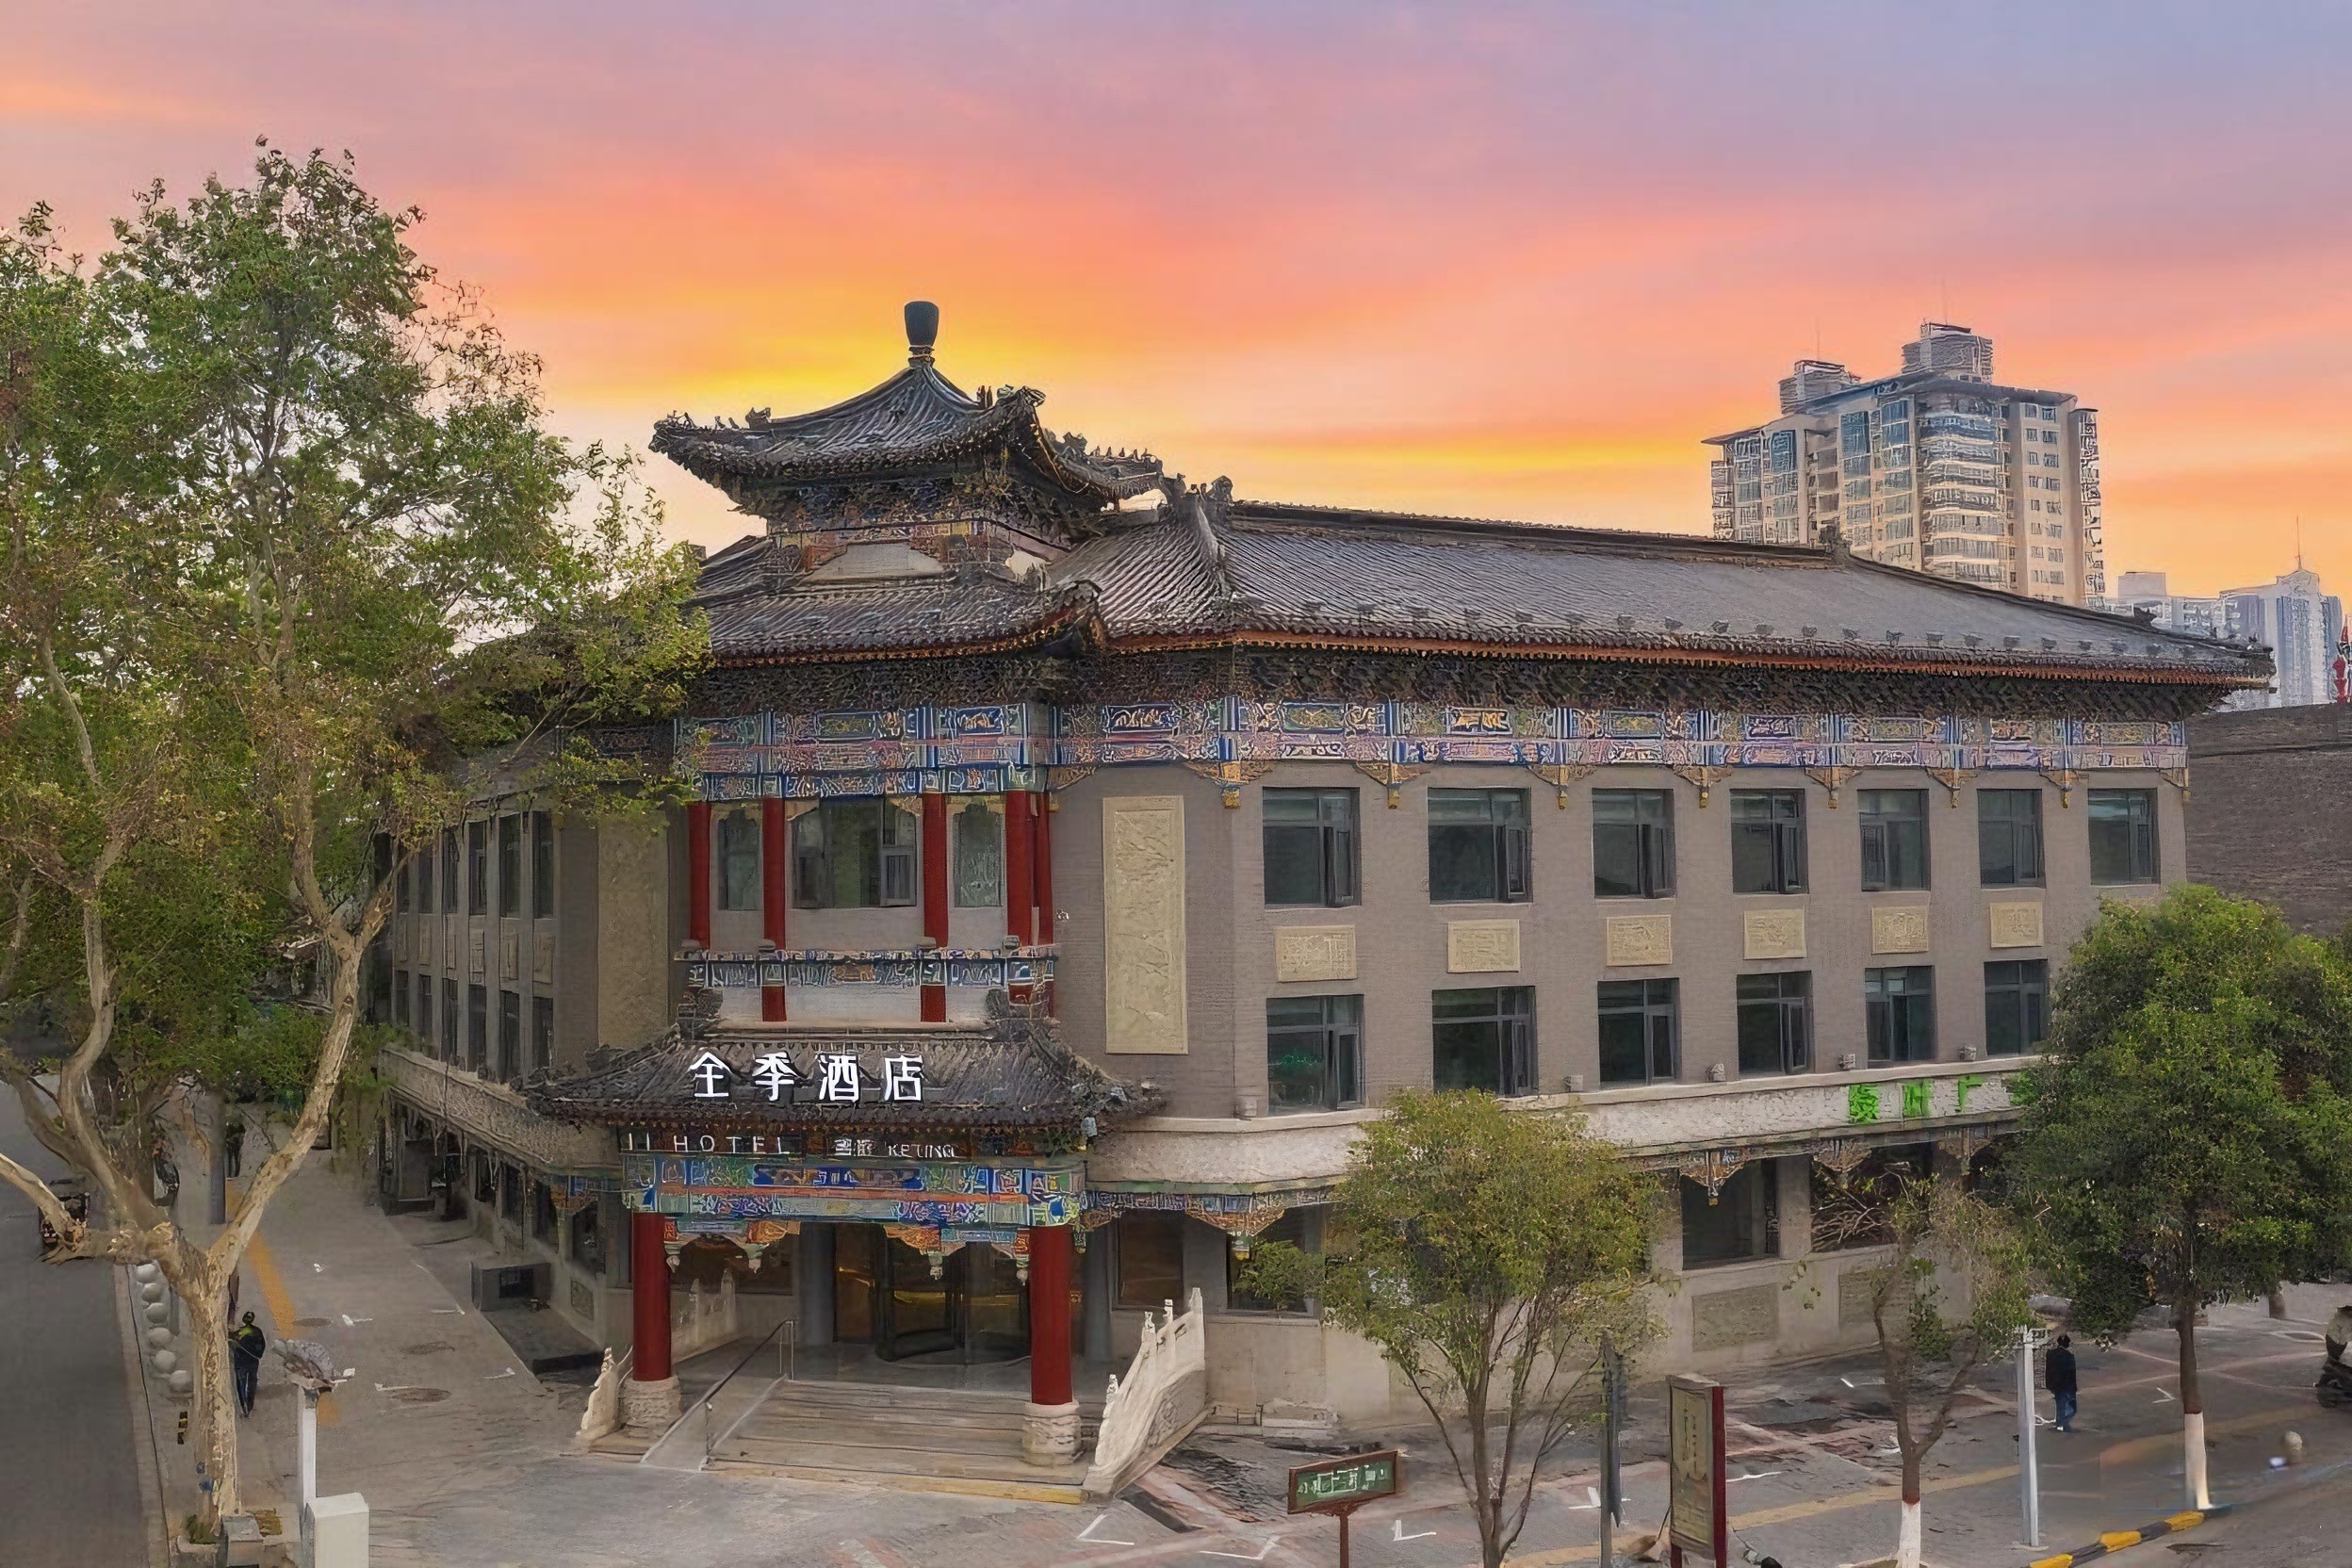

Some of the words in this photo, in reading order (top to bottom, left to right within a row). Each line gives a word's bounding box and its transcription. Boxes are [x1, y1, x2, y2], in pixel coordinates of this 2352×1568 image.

[688, 1052, 923, 1102] 全季酒店
[674, 1135, 790, 1154] HOTEL
